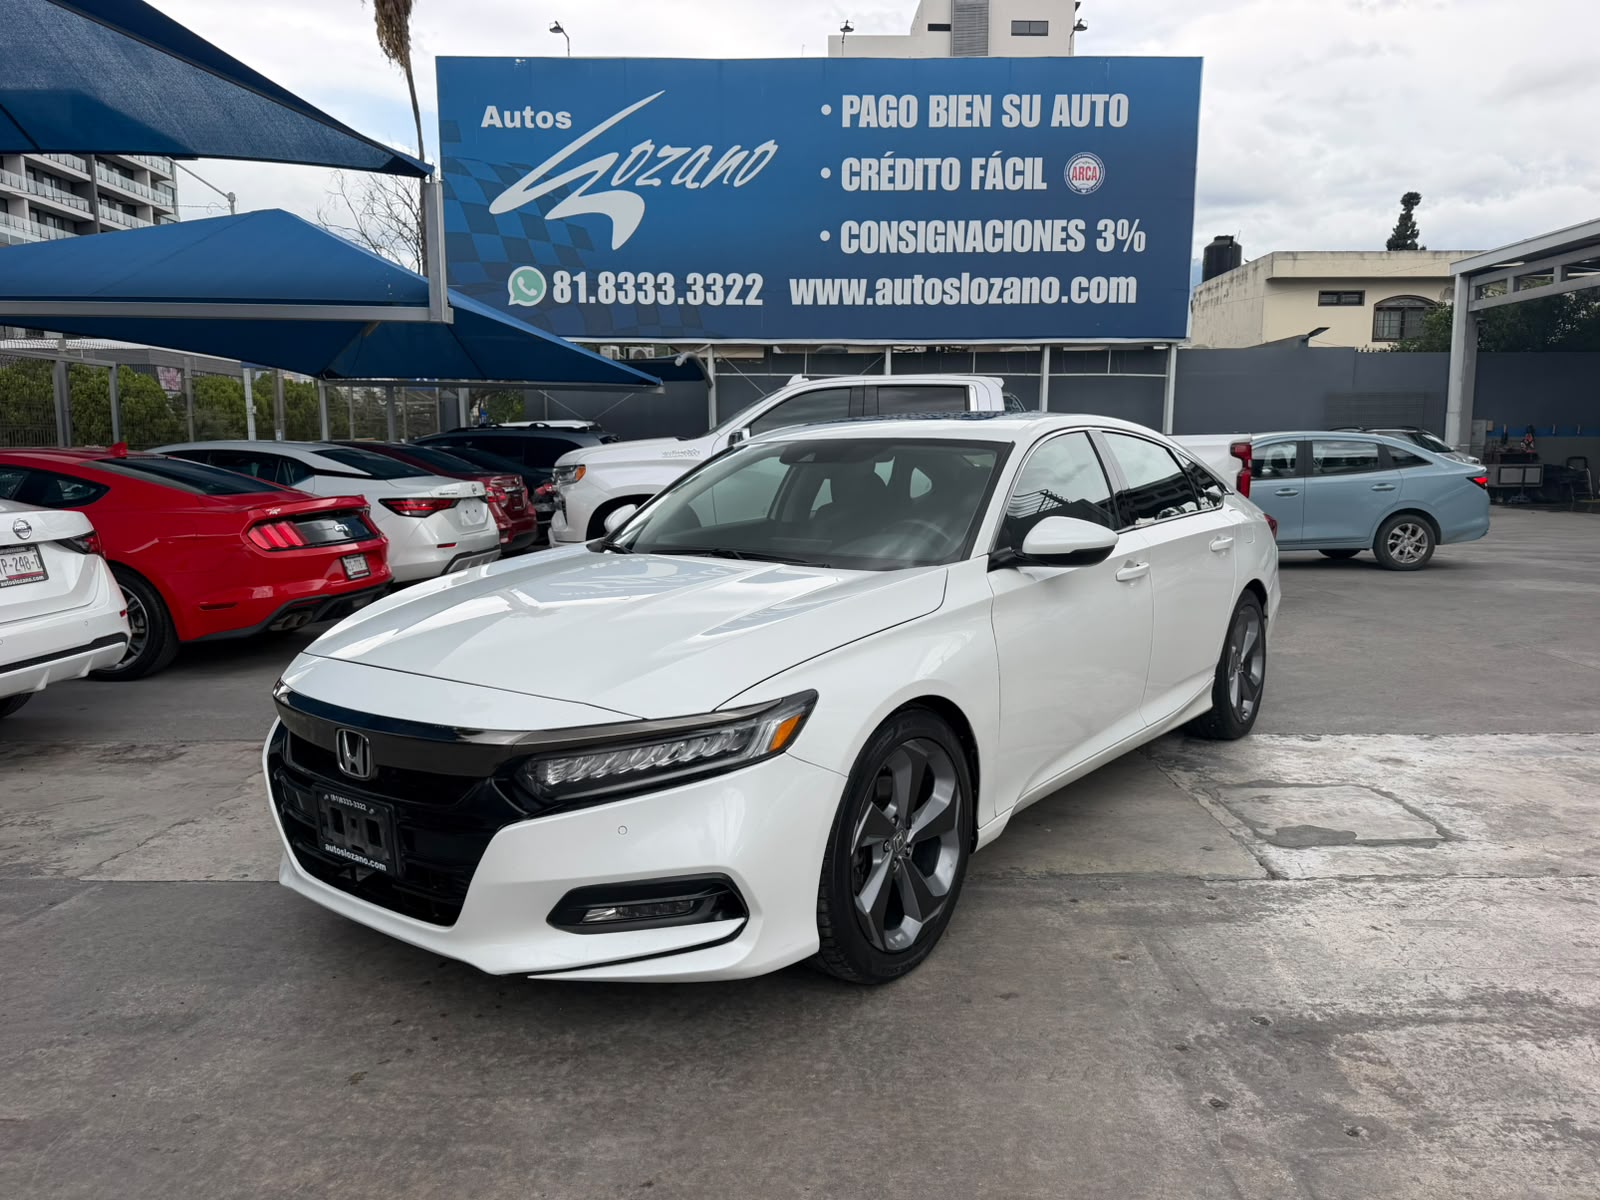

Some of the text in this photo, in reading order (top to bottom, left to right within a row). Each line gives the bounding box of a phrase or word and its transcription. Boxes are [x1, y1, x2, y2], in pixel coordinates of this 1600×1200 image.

[480, 105, 572, 129] Autos
[841, 93, 1129, 128] PAGO BIEN SU AUTO
[841, 150, 1047, 191] CRÉDITO FÁCIL
[1071, 165, 1098, 181] ARCA
[840, 218, 1146, 254] CONSIGNACIONES 3%
[553, 270, 764, 306] 81.8333.3322
[789, 272, 1137, 306] www.autoslozano.com
[324, 843, 387, 872] autoslozano.com
